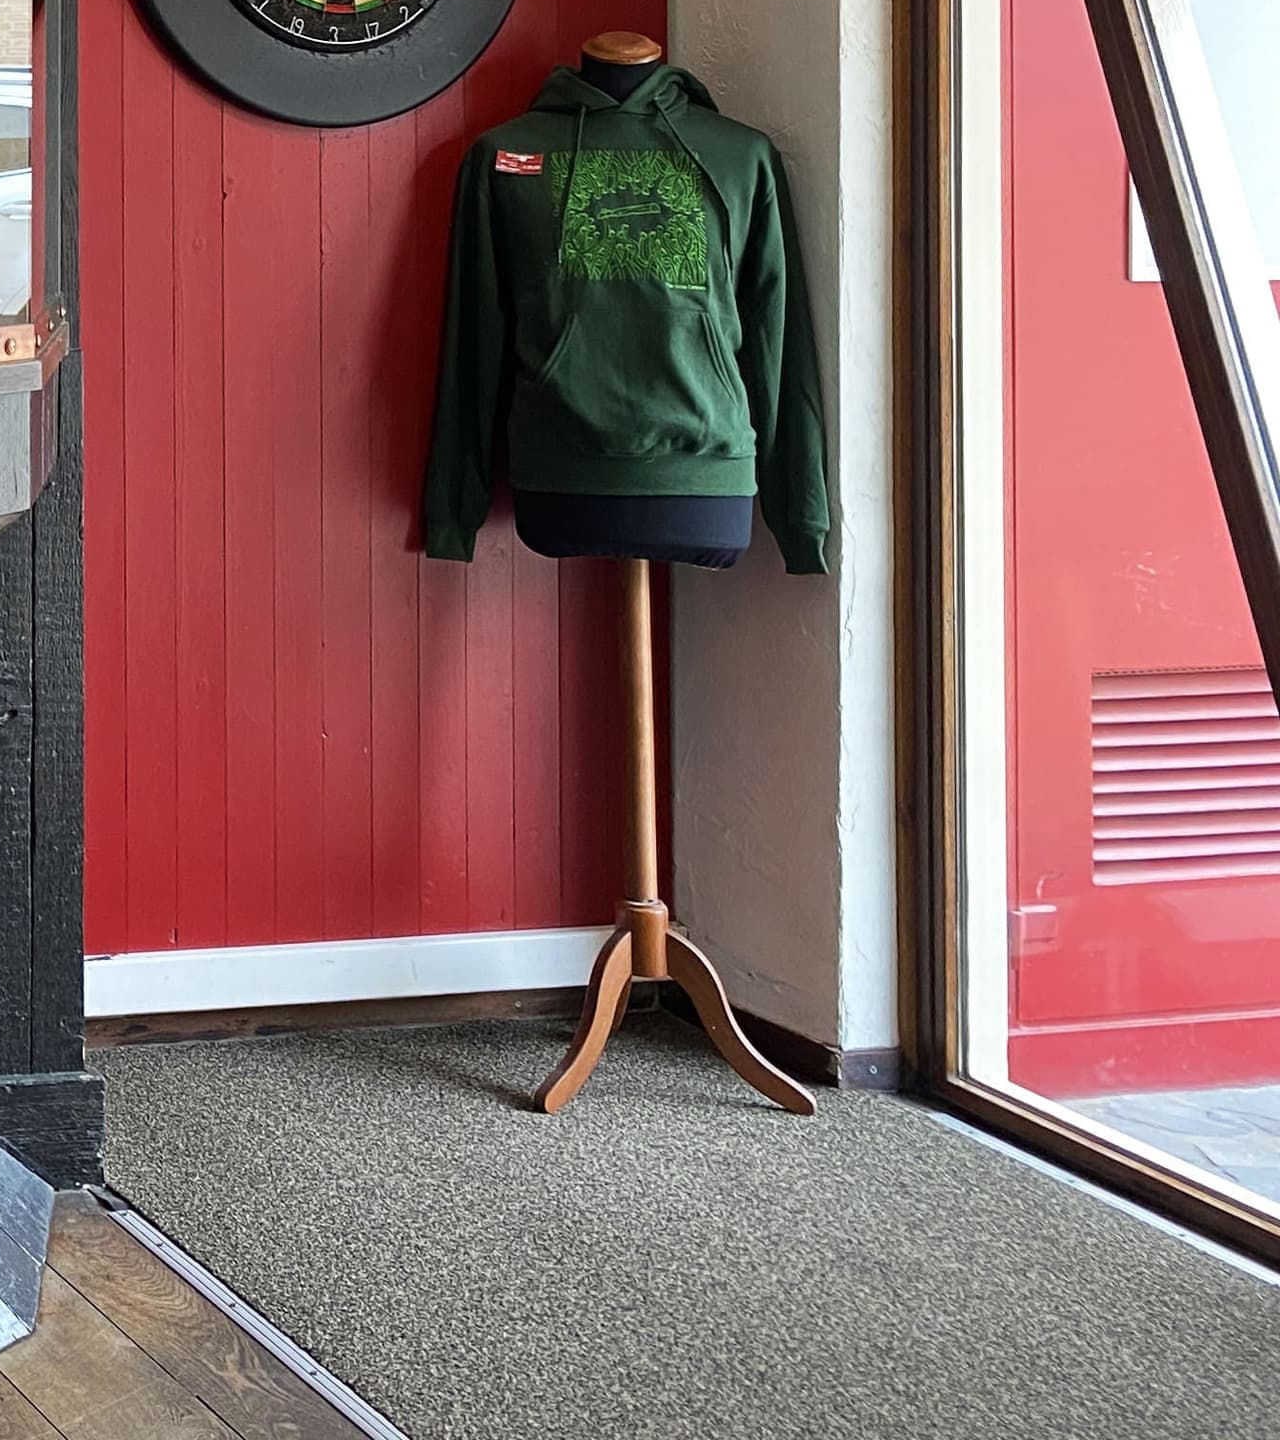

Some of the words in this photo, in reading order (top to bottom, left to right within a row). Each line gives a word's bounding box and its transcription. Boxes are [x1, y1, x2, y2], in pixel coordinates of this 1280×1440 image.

[400, 6, 409, 21] 2
[290, 16, 304, 35] 19
[365, 22, 380, 38] 17
[329, 26, 340, 42] 3
